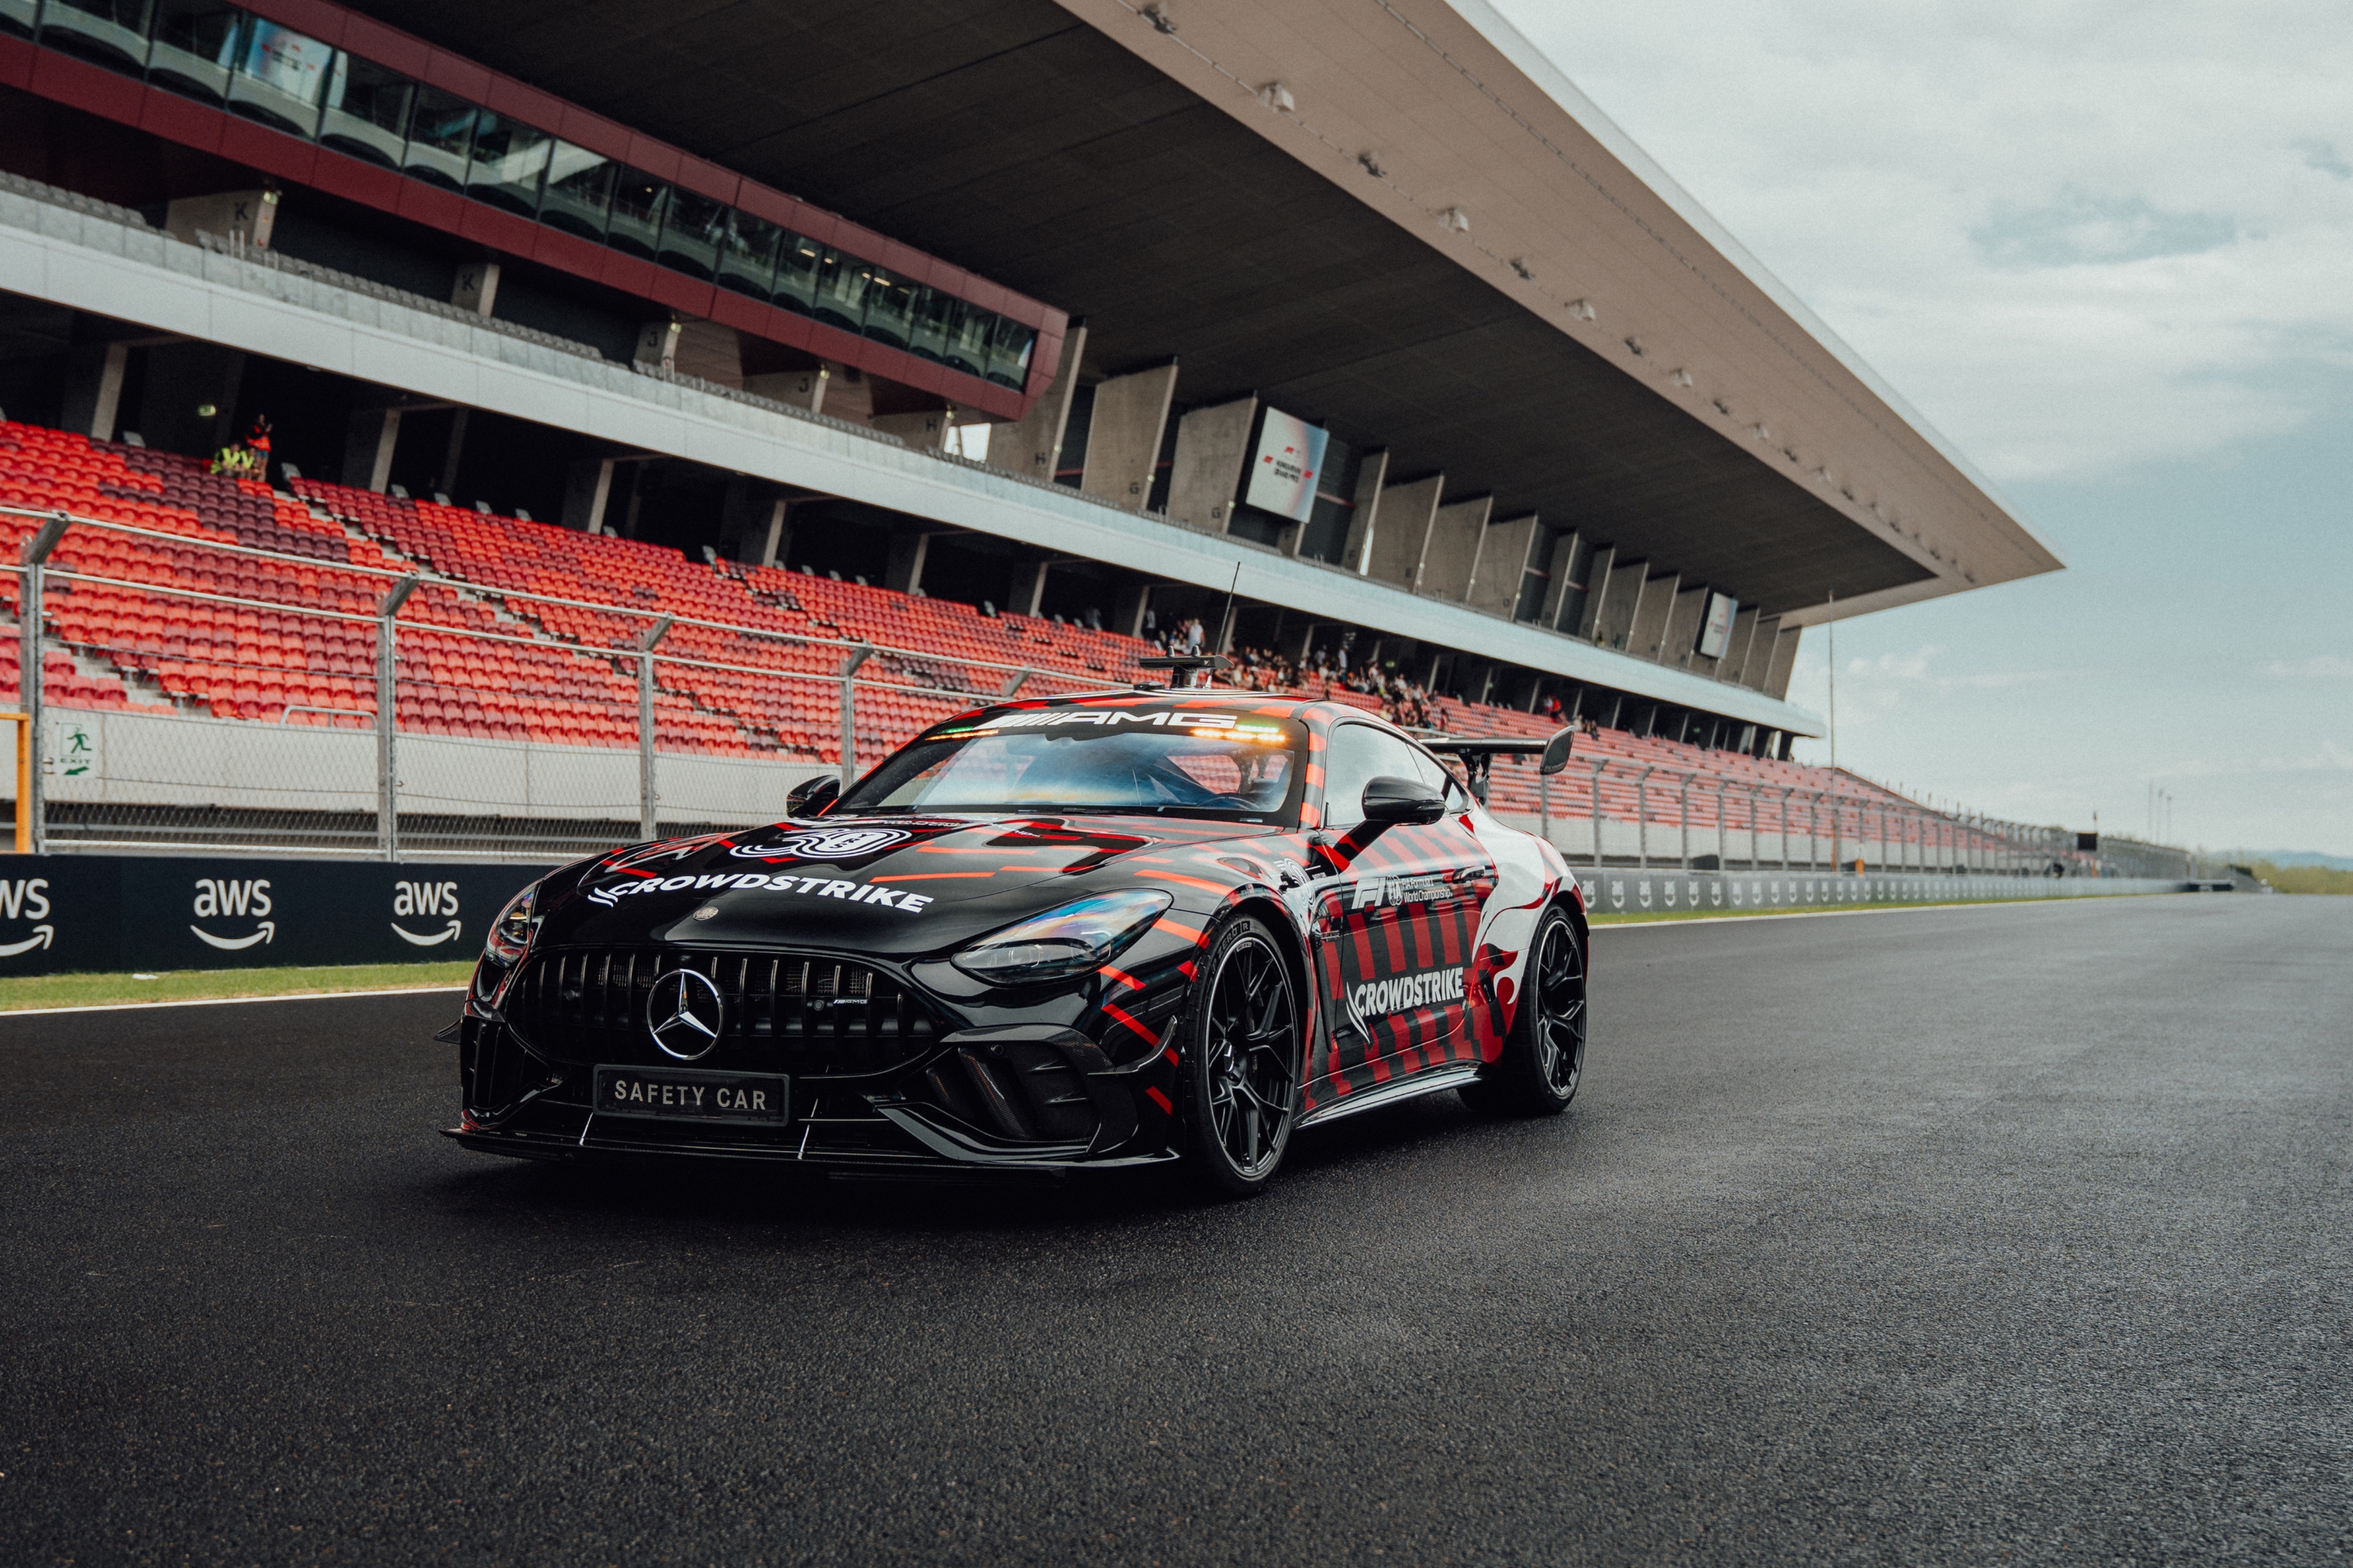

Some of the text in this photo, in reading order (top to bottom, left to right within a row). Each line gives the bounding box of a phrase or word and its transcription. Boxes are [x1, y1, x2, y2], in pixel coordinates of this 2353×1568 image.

[194, 878, 272, 917] aws
[394, 880, 458, 916] aws
[610, 874, 934, 913] CROWDSTRIKE
[1404, 890, 1419, 903] World
[1410, 877, 1430, 889] Formula
[1355, 967, 1464, 1017] CROWDSTRIKE
[614, 1080, 766, 1110] SAFETY CAR
